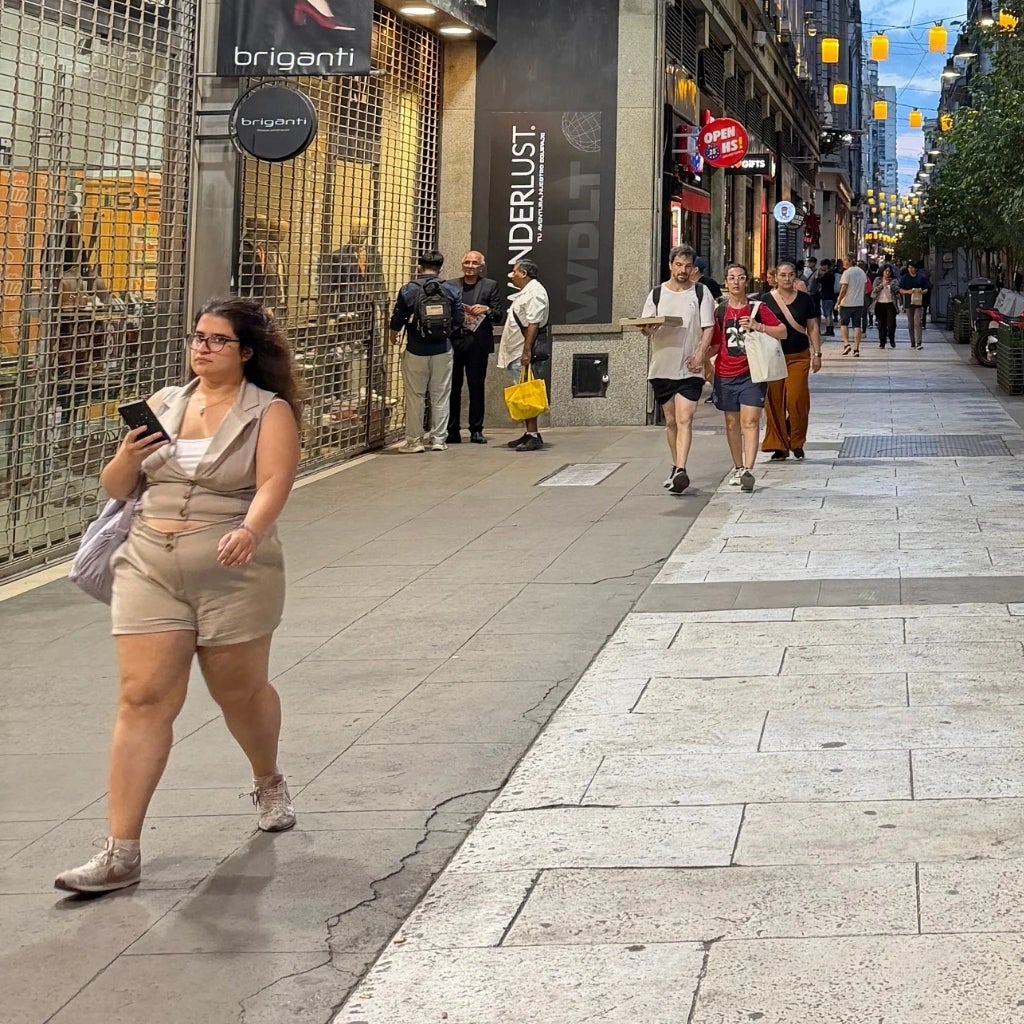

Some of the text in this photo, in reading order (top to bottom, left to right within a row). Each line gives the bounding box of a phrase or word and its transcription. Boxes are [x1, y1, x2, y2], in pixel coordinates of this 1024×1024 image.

[234, 45, 355, 71] briganti
[241, 117, 307, 128] briganti
[703, 126, 736, 144] OPEN
[721, 136, 743, 154] HS!
[741, 159, 766, 169] GIFTS
[507, 125, 536, 312] NDERLUST.
[566, 160, 600, 323] WDLT
